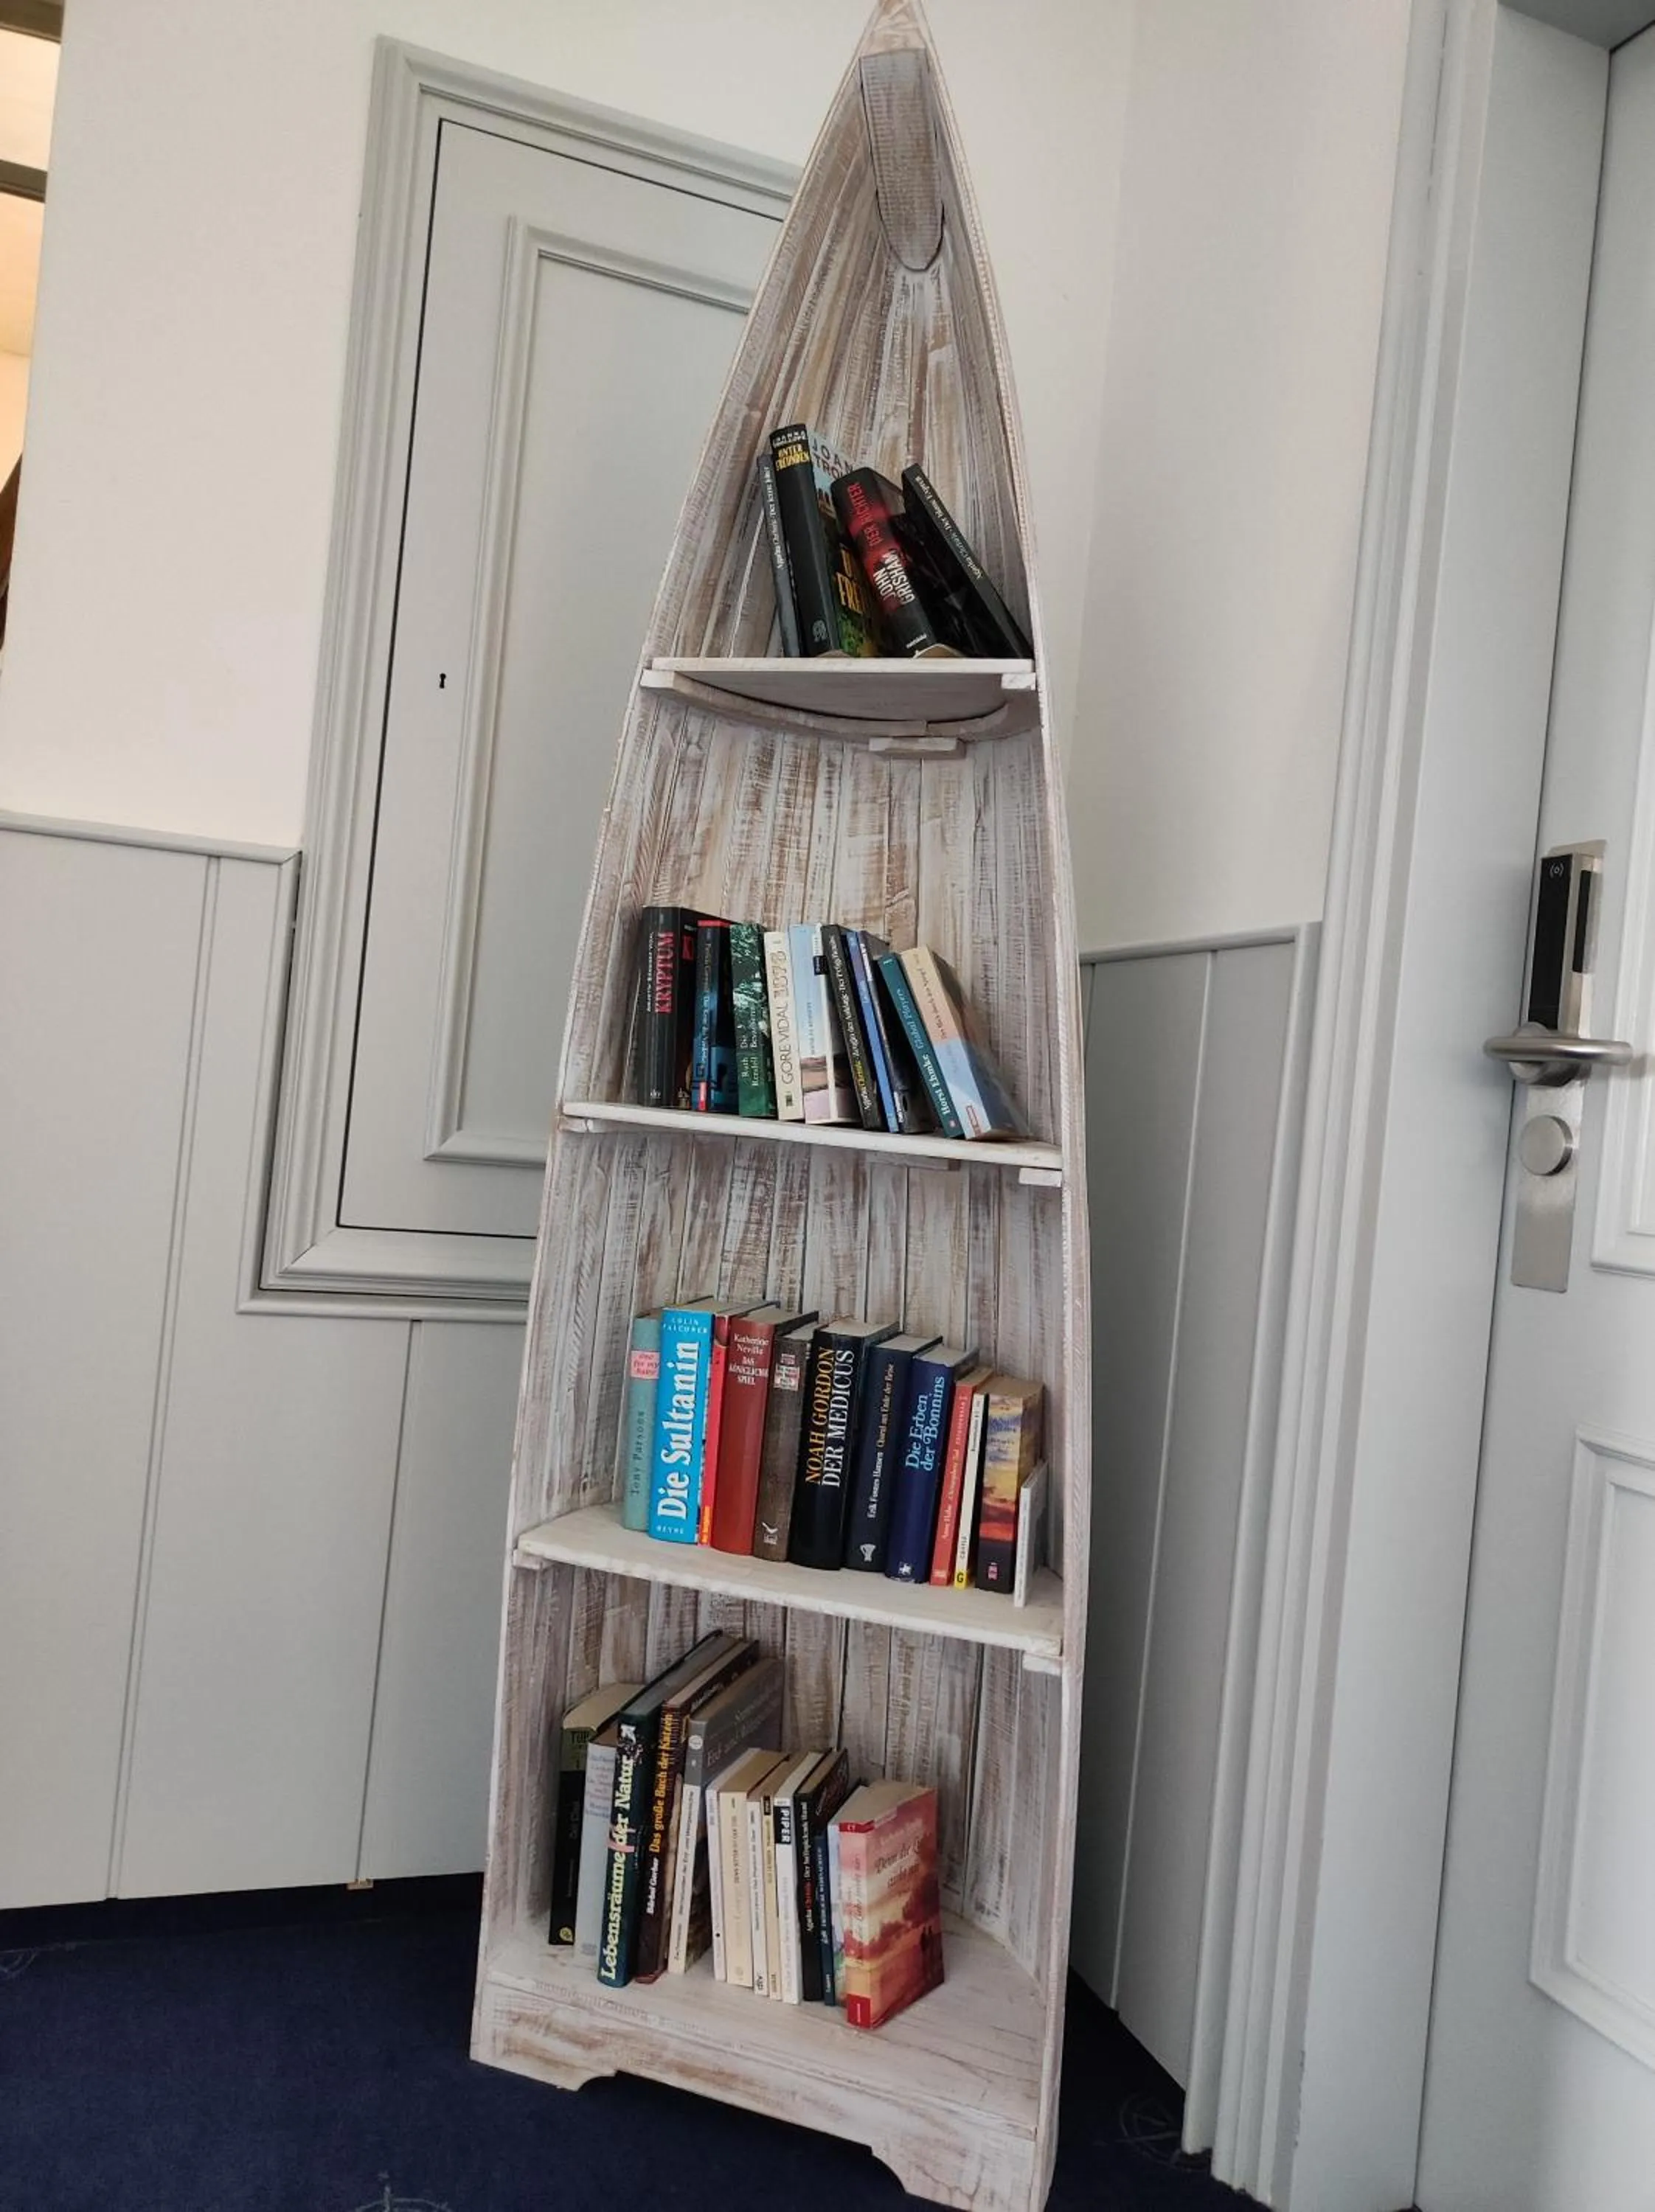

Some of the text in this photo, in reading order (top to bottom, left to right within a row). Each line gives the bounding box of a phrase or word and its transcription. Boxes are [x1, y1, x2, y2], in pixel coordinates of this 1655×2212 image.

[847, 483, 881, 546] DER RICHTER
[872, 568, 897, 602] JOHN
[882, 549, 915, 605] GRISHAM
[655, 931, 674, 1014] KRYPTUM
[775, 1002, 790, 1040] VIDAL
[779, 1044, 793, 1084] GORE
[922, 1054, 940, 1088] Ehmke
[935, 1088, 951, 1115] Horst
[630, 1411, 645, 1494] Tony Parsons
[656, 1340, 700, 1521] Die Sultanin
[805, 1346, 836, 1484] NOAH GORDON
[822, 1349, 855, 1487] DER MEDICUS
[905, 1394, 929, 1469] Die Erben
[920, 1376, 945, 1471] der Bonnins
[650, 1712, 673, 1853] Das große Buch der Katzen
[780, 1808, 791, 1843] PIPER
[601, 1756, 634, 1979] Lebensräume der Natur
